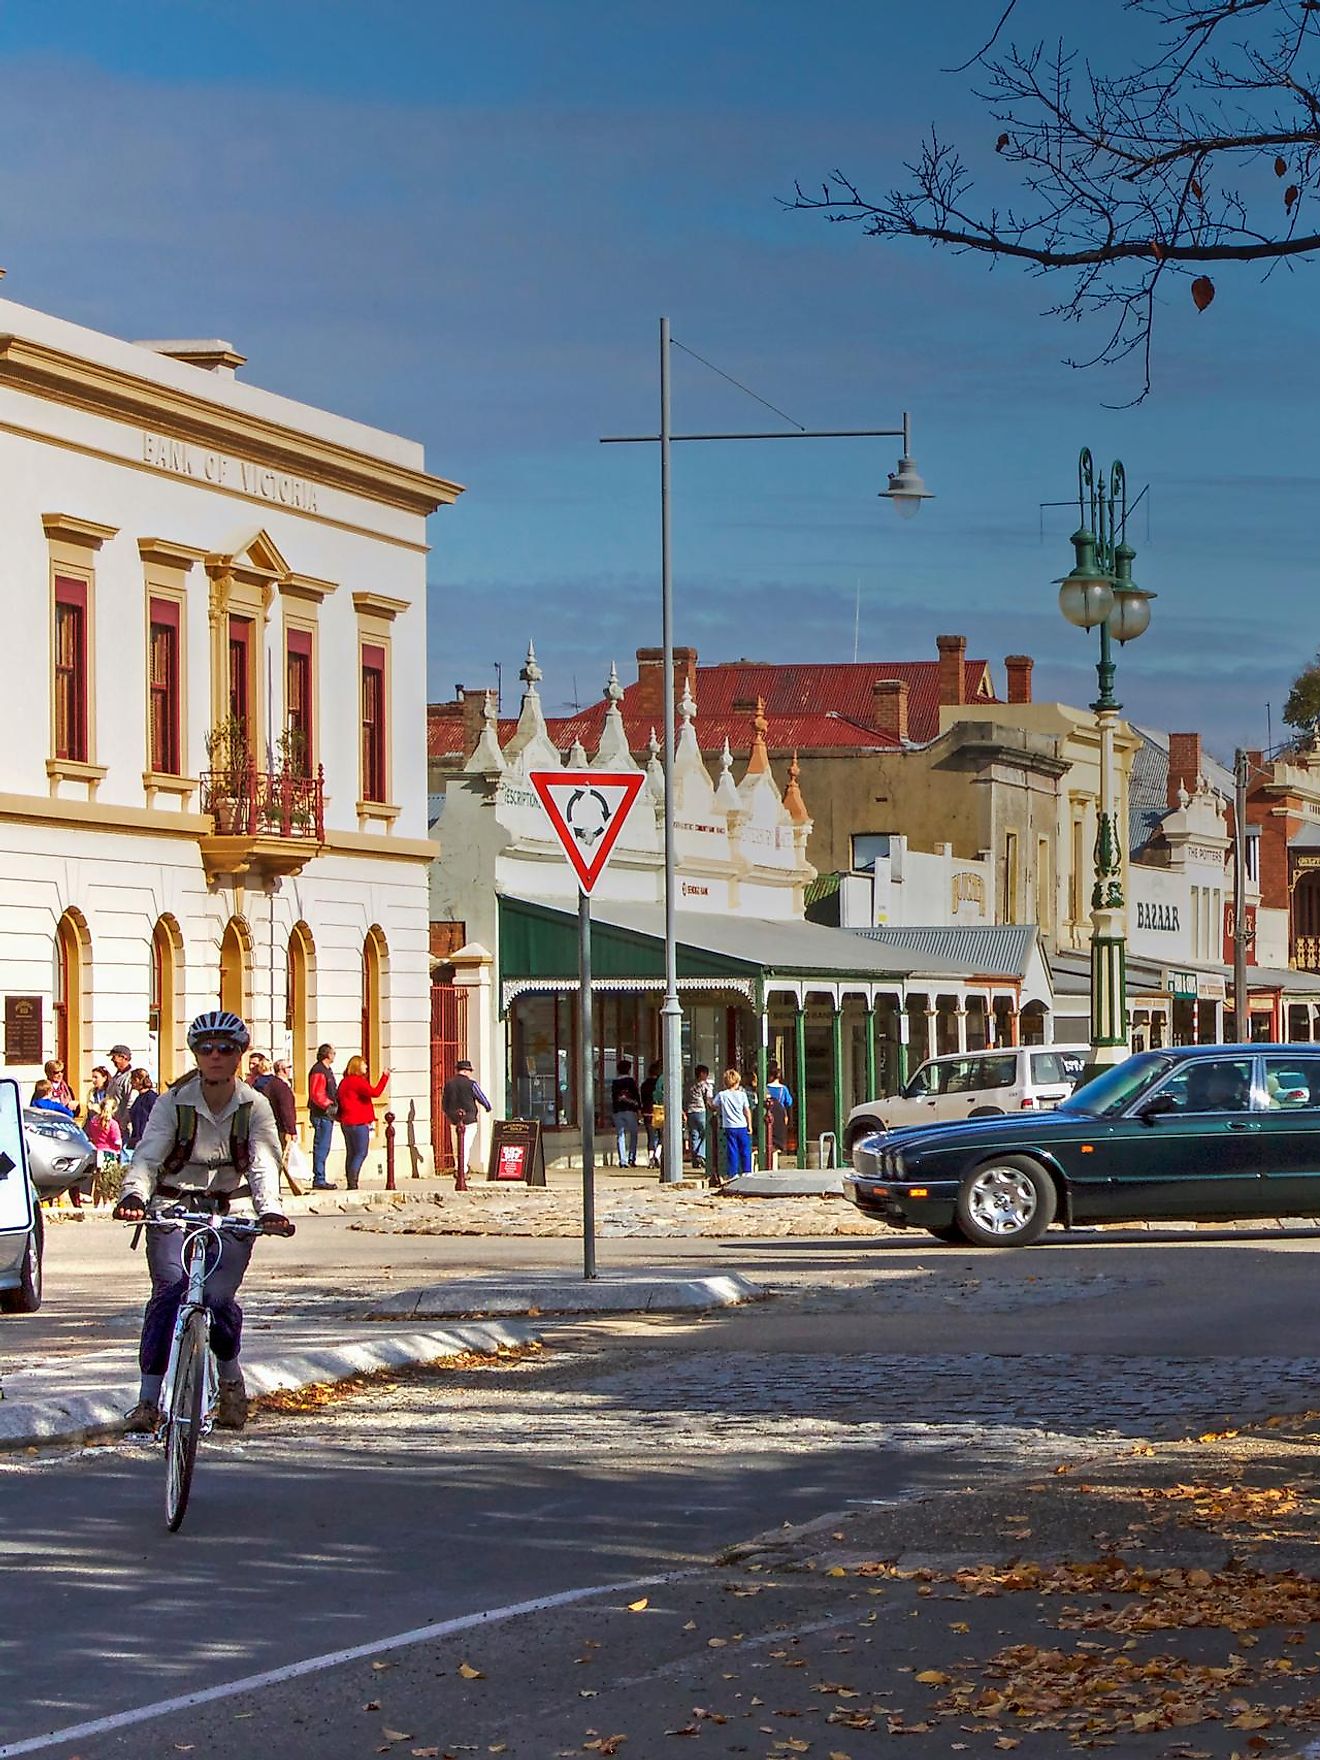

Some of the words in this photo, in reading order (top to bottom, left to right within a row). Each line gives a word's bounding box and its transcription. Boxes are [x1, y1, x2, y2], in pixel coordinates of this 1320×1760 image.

[143, 432, 192, 475] BANK
[204, 453, 227, 483] OF
[240, 462, 317, 513] VICTORIA
[1188, 846, 1198, 859] THE
[1199, 848, 1222, 862] POTTERS
[1137, 902, 1180, 931] BAZAAR
